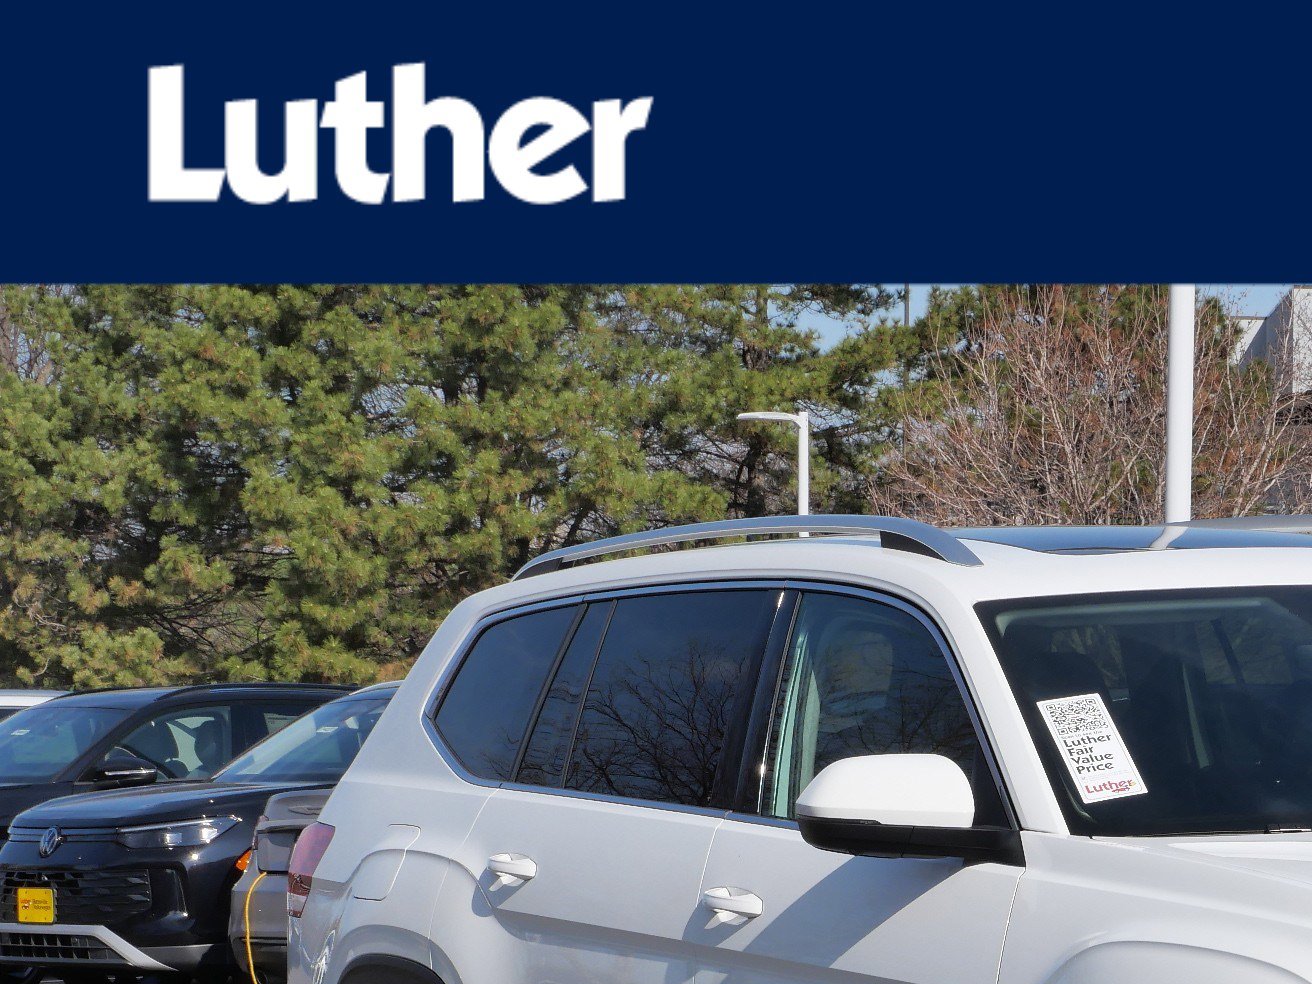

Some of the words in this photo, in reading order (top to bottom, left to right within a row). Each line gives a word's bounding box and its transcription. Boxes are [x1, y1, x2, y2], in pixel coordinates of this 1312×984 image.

[1063, 734, 1111, 748] Luther
[1067, 746, 1094, 757] Fair
[1071, 753, 1114, 765] Value
[1076, 762, 1114, 774] Price
[1085, 779, 1133, 794] Luther
